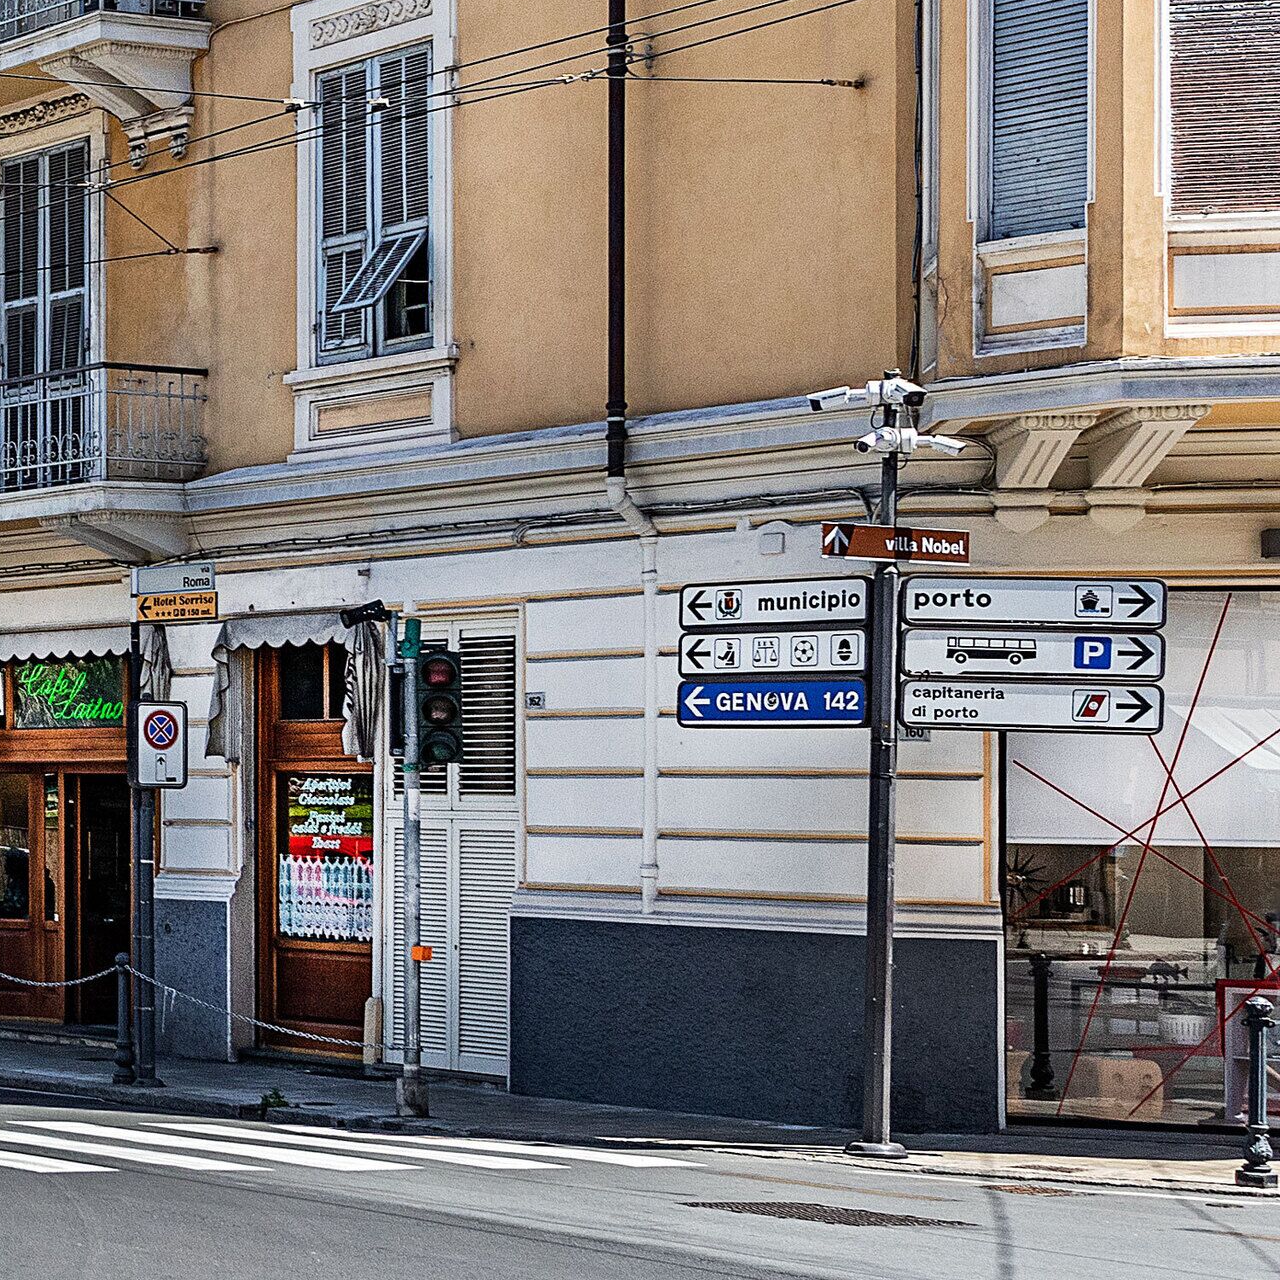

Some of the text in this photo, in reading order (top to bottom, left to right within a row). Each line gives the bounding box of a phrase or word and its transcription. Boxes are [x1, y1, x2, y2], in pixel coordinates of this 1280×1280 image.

[885, 536, 966, 556] villa Nobel
[183, 576, 210, 588] Roma
[153, 594, 214, 607] Hotel Sorriso
[758, 590, 861, 612] municipio
[913, 588, 992, 610] porto
[1083, 641, 1105, 665] P
[52, 672, 123, 719] Latino
[716, 690, 860, 712] GENOVA 142
[912, 687, 1005, 701] capitaneria
[911, 704, 979, 720] di porto
[905, 727, 924, 738] 160
